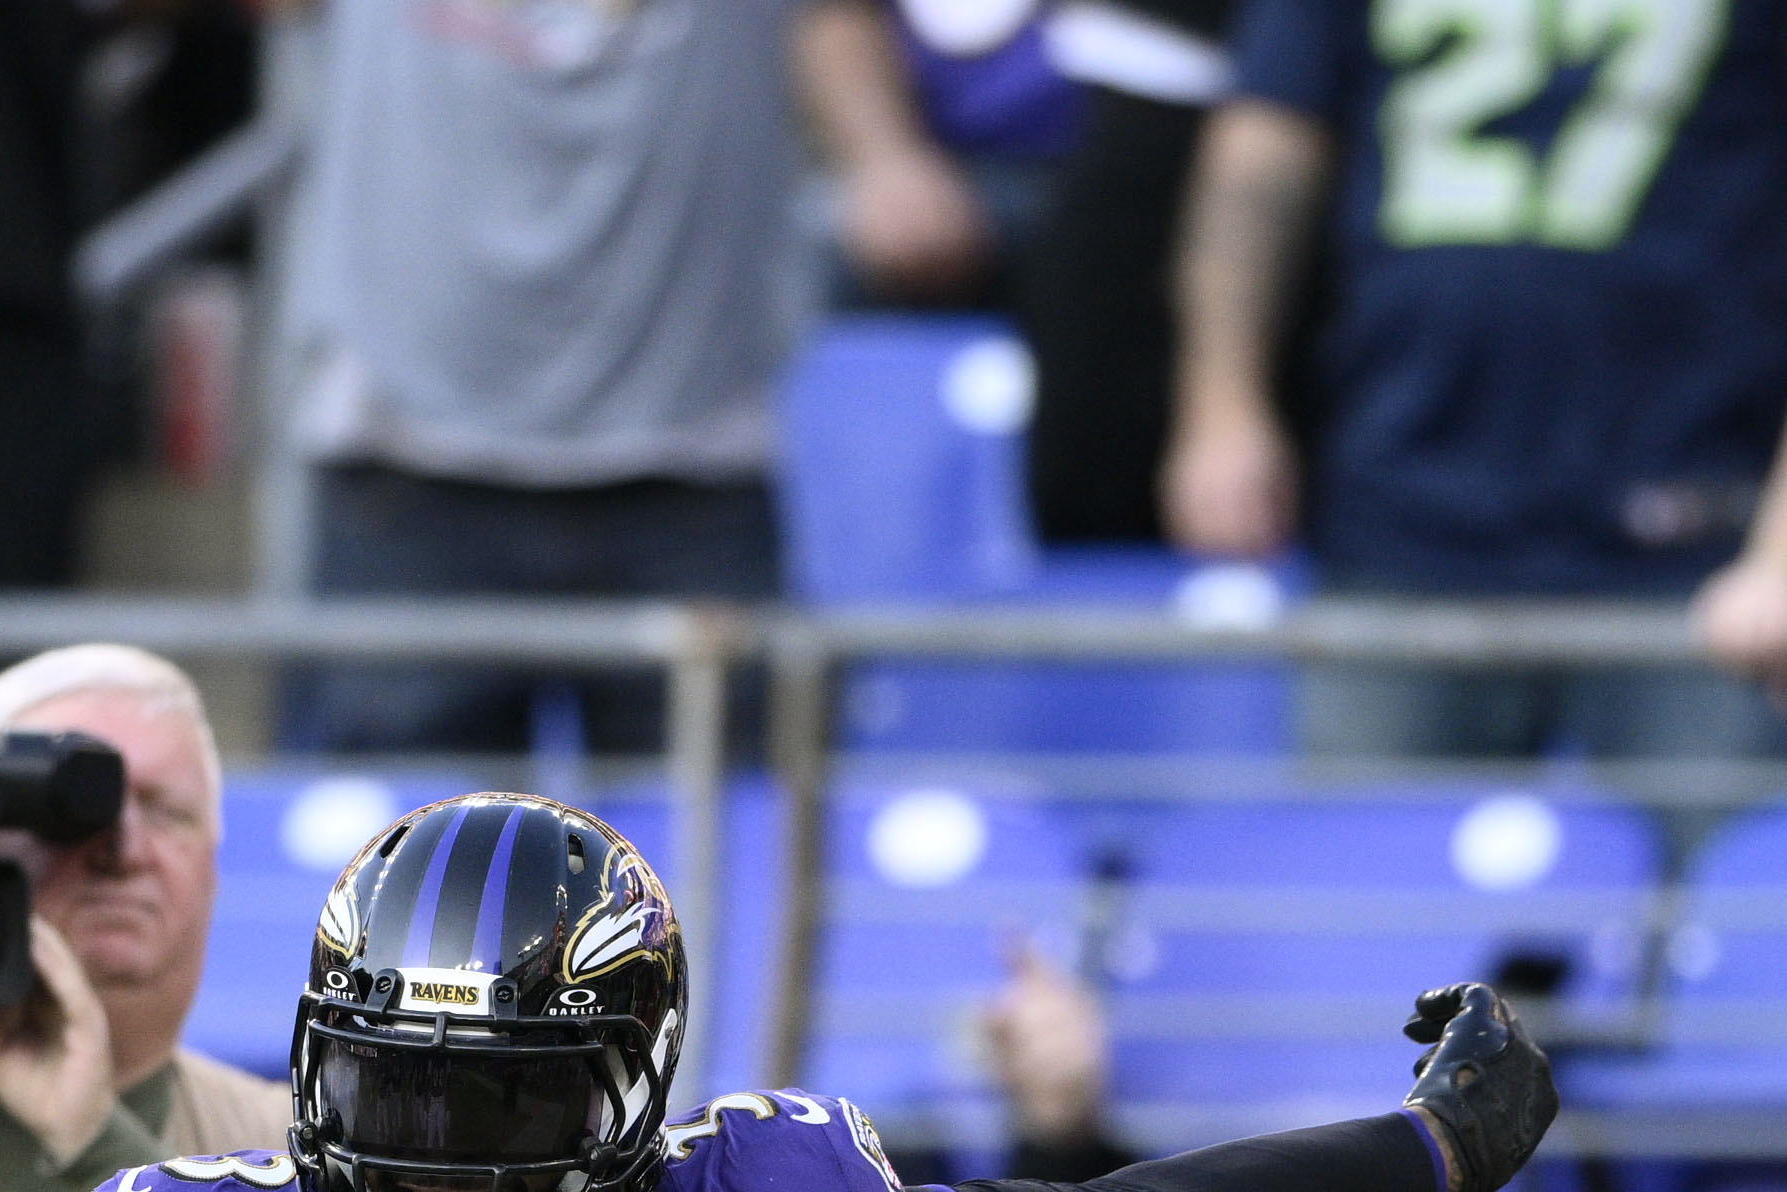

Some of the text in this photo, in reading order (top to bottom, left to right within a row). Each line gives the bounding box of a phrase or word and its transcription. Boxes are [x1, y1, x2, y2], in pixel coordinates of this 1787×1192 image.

[1368, 0, 1730, 252] 27
[409, 981, 480, 1006] RAVENS
[548, 1005, 605, 1016] OAKLEY
